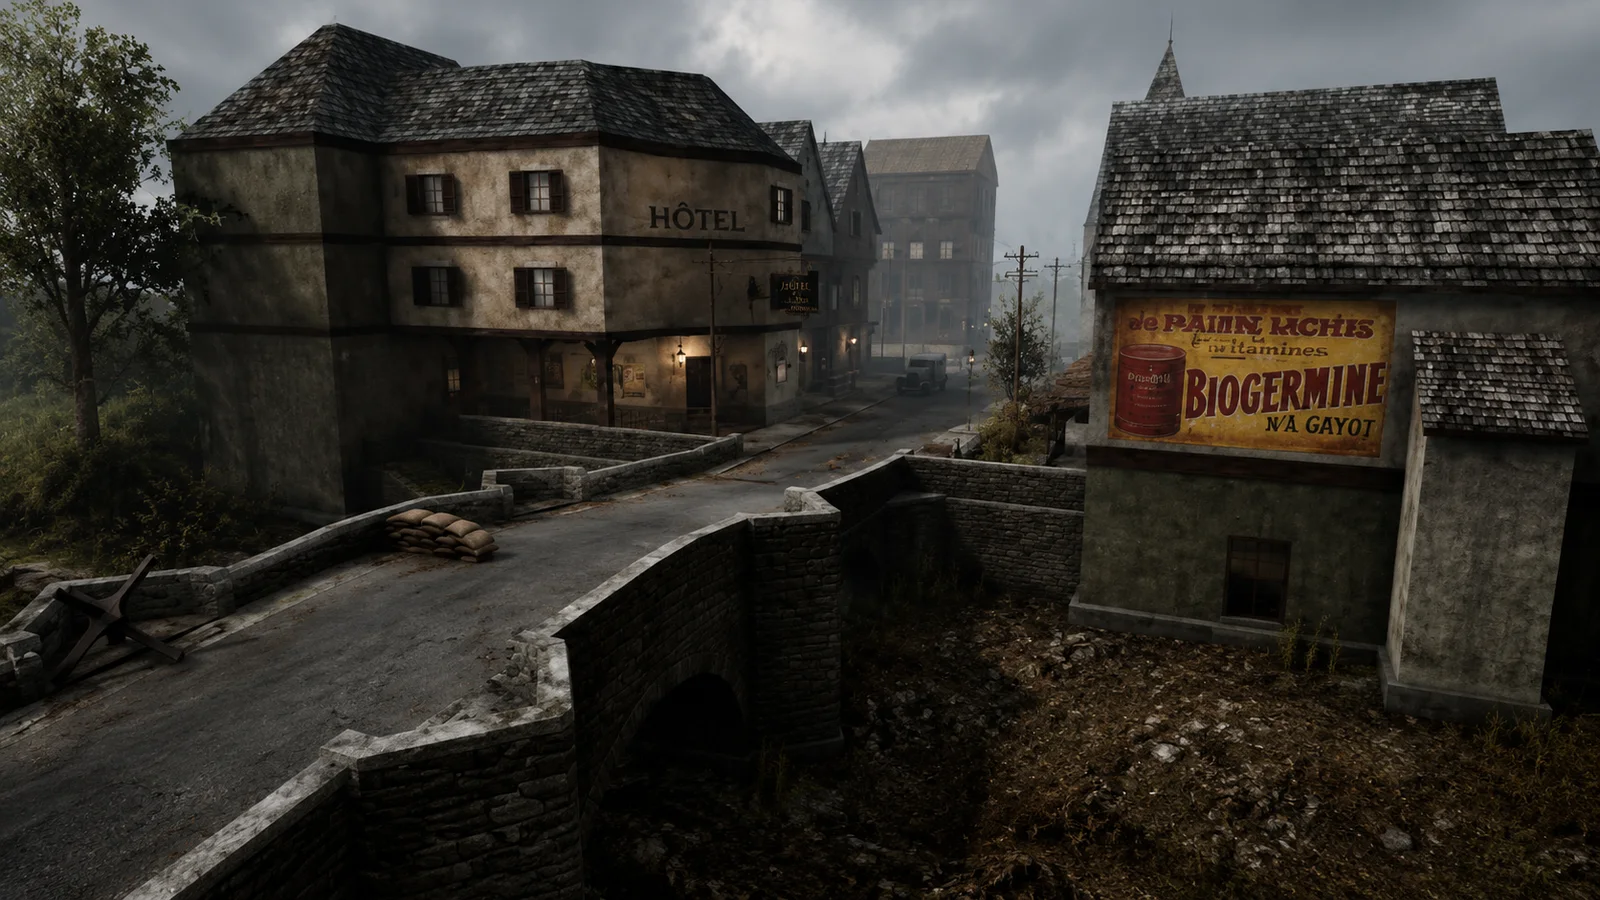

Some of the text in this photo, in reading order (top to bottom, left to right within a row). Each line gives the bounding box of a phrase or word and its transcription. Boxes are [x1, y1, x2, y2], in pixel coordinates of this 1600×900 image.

[649, 202, 745, 232] HÔTEL
[1185, 361, 1387, 420] BIOGERMINE
[1306, 415, 1376, 438] GAYOT
